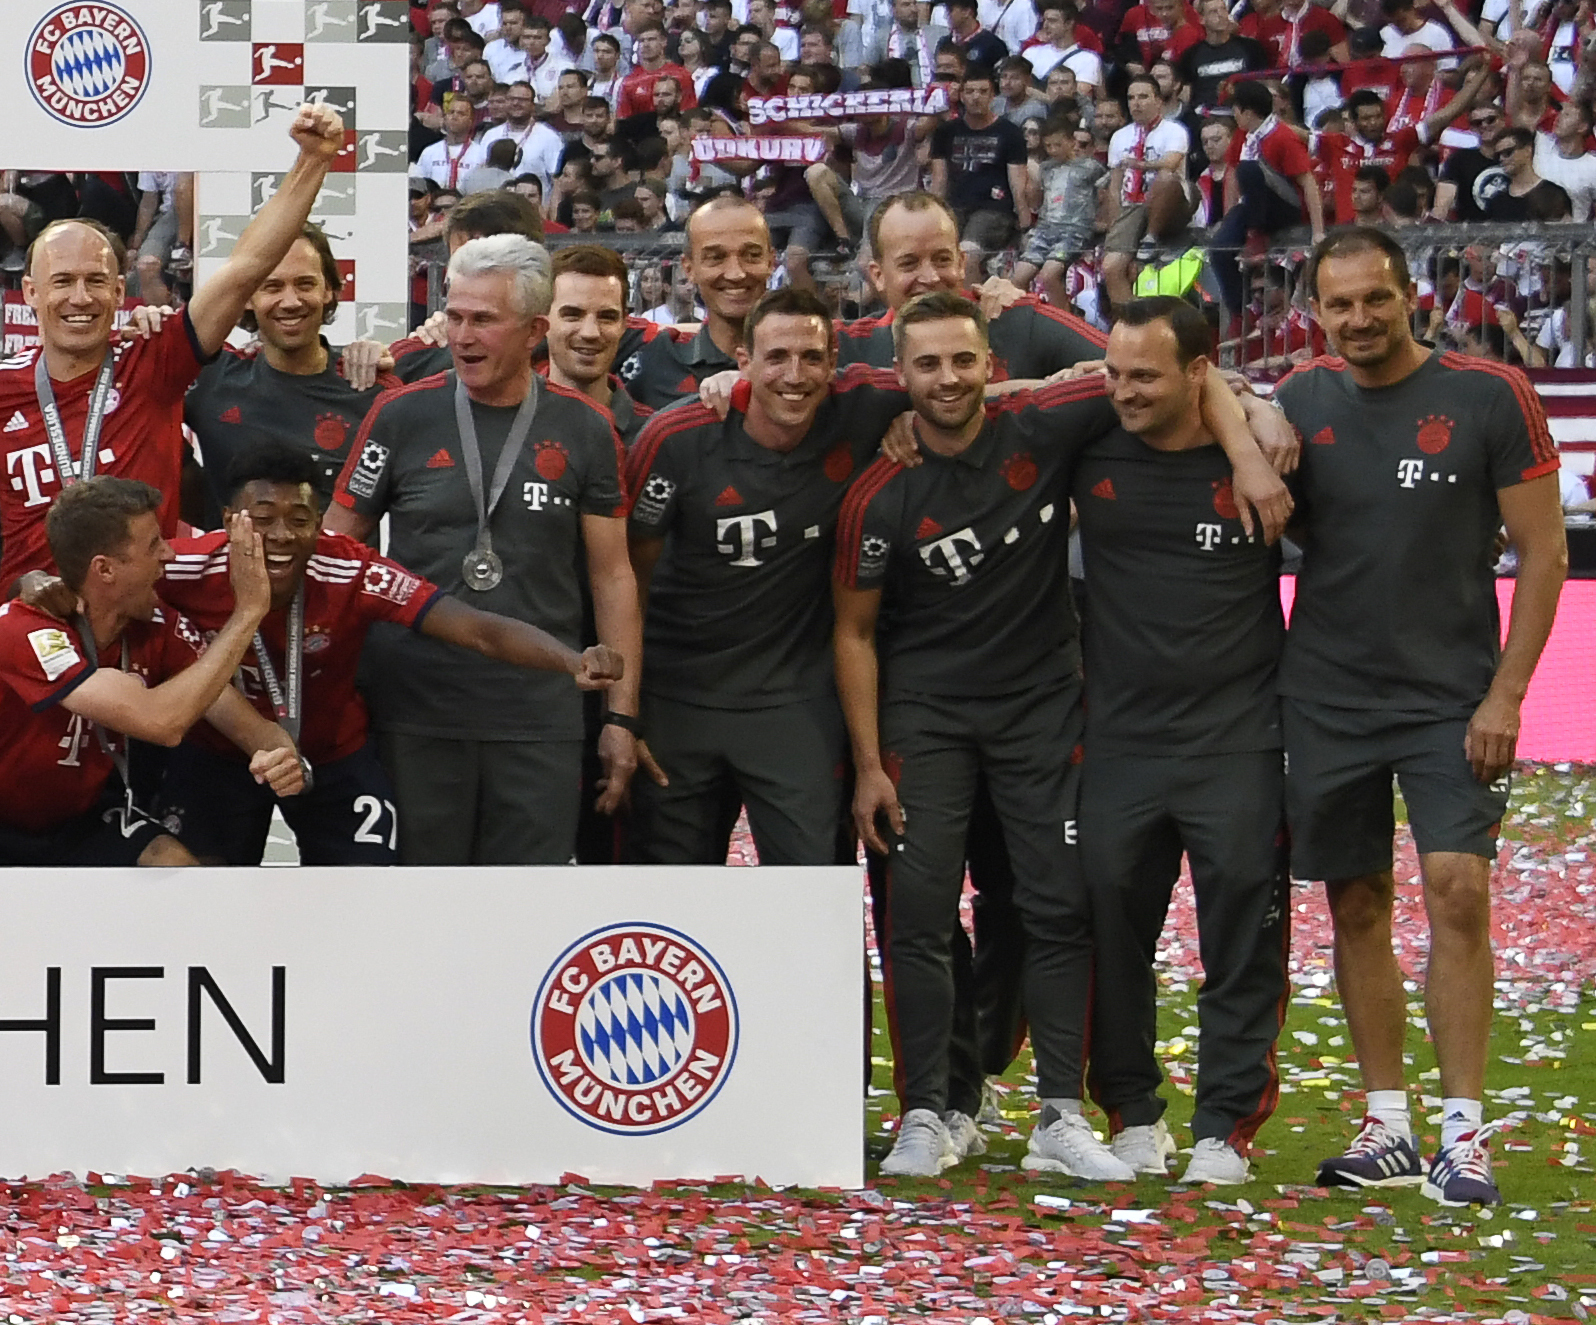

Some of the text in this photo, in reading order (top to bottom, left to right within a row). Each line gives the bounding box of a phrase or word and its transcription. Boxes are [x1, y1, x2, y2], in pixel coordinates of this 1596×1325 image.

[35, 7, 143, 56] FC BAYERN
[36, 74, 141, 120] MÜNCHEN
[746, 87, 950, 126] SCHICKERIA
[44, 403, 71, 478] BUNDESLIGA
[548, 937, 723, 1014] FC BAYERN
[549, 1048, 721, 1122] MÜNCHEN
